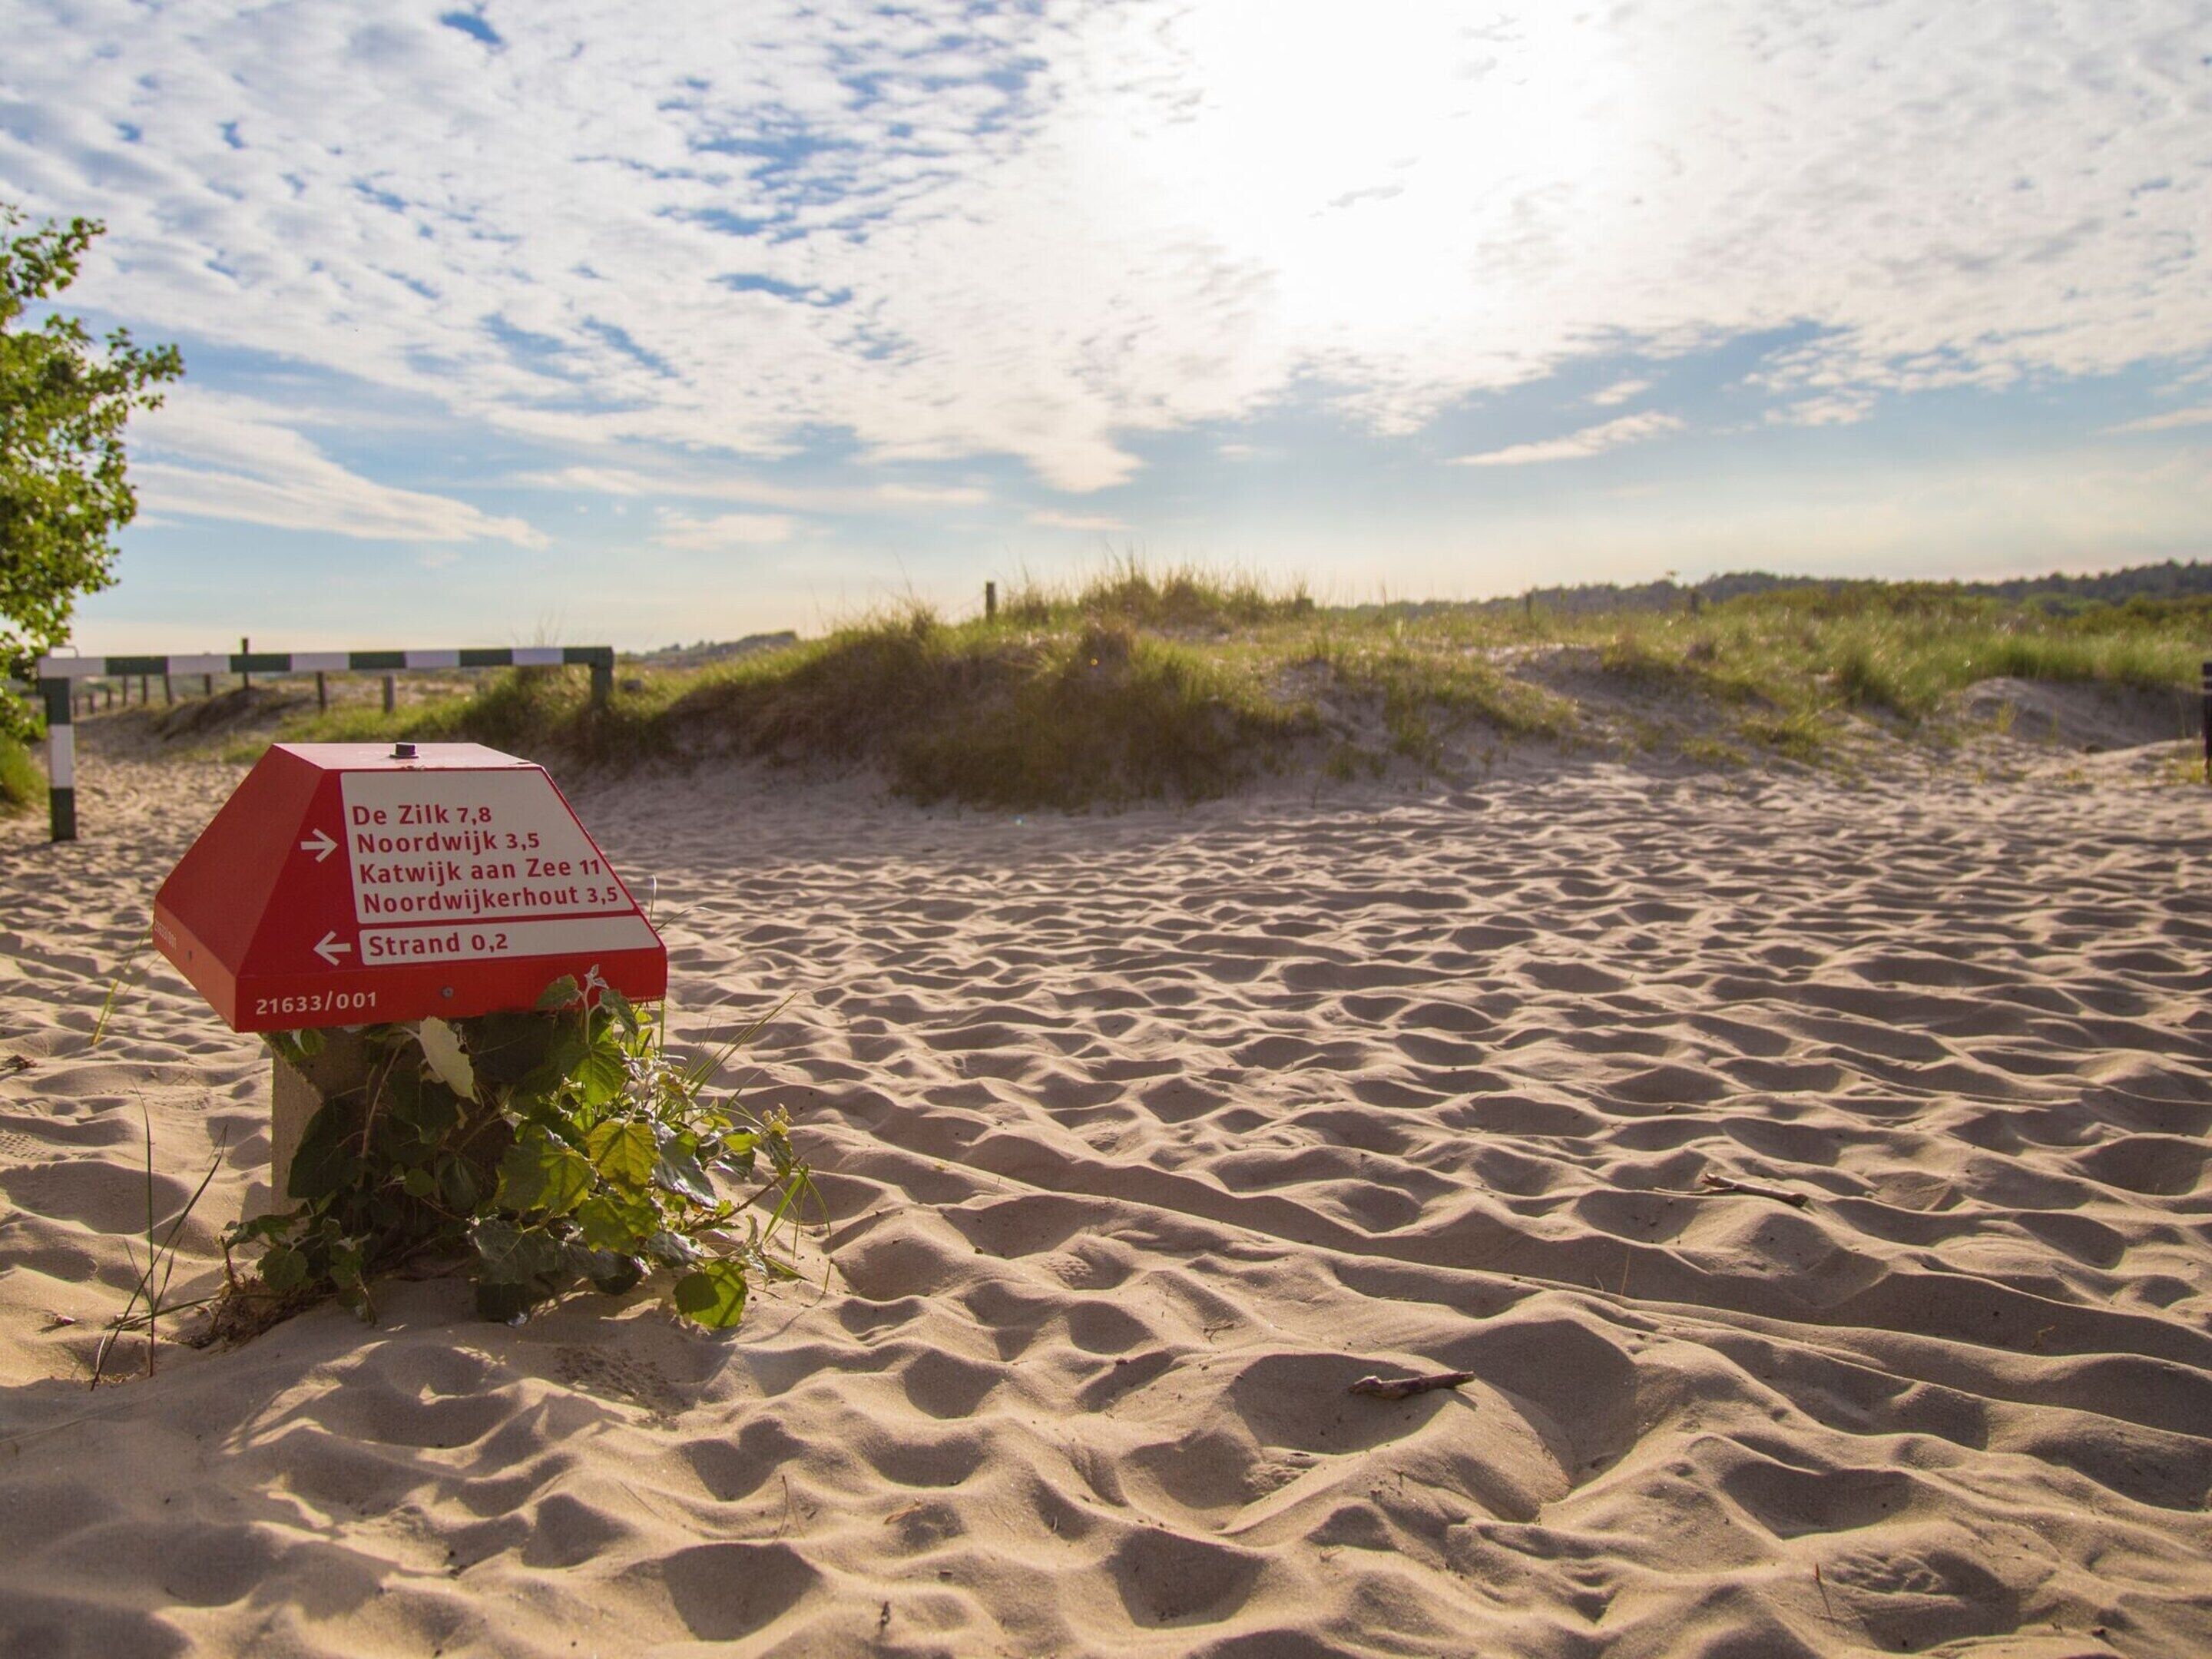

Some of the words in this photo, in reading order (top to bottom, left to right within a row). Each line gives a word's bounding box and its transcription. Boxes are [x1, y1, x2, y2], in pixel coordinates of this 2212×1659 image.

[353, 805, 387, 825] De
[399, 804, 450, 825] Zilk
[457, 806, 492, 825] 7,8
[357, 831, 498, 855] Noordwijk
[506, 833, 540, 849] 3,5
[360, 861, 462, 886] Katwijk
[471, 863, 515, 880] aan
[526, 858, 571, 878] Zee
[579, 859, 601, 875] 11
[363, 886, 579, 914] Noordwijkerhout
[588, 886, 618, 905] 3,5
[369, 932, 460, 956] Strand
[472, 933, 508, 953] 0,2
[256, 991, 376, 1015] 21633/001
